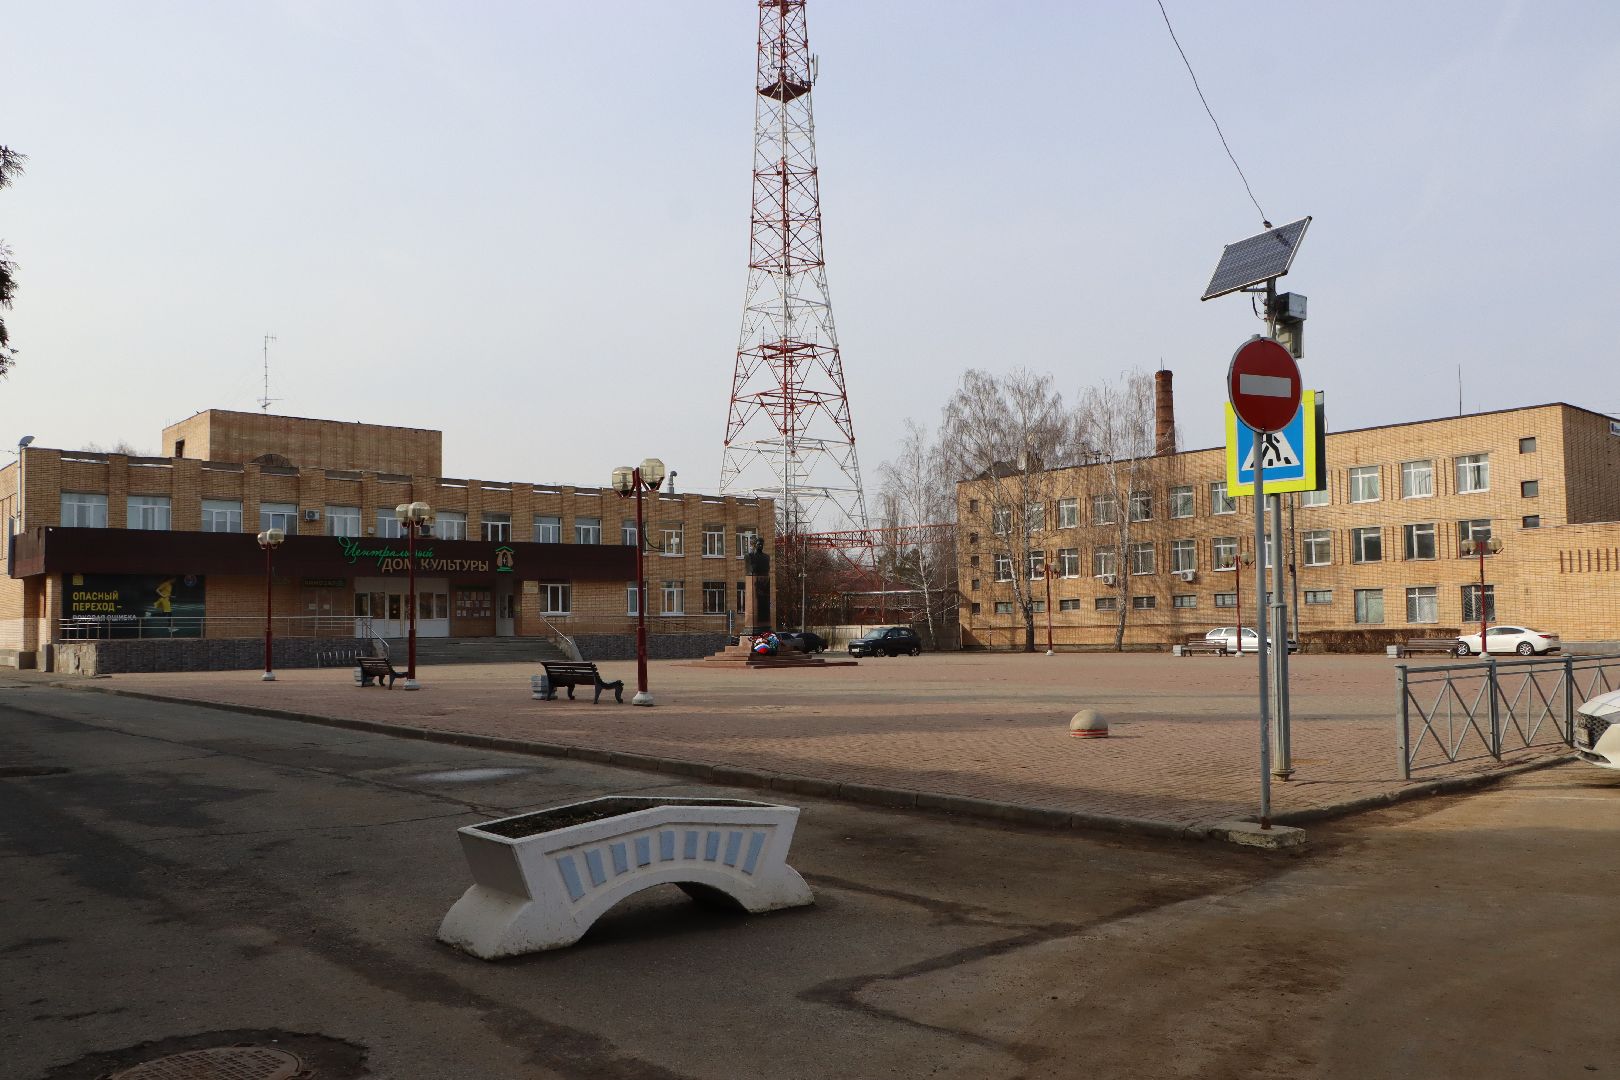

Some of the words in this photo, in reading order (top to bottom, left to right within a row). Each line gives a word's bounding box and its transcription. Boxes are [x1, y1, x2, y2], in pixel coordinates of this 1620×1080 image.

[421, 559, 489, 572] КУЛЬТУРЫ
[73, 591, 118, 600] ОПАСНЫЙ
[73, 602, 115, 611] ПЕРЕХОД
